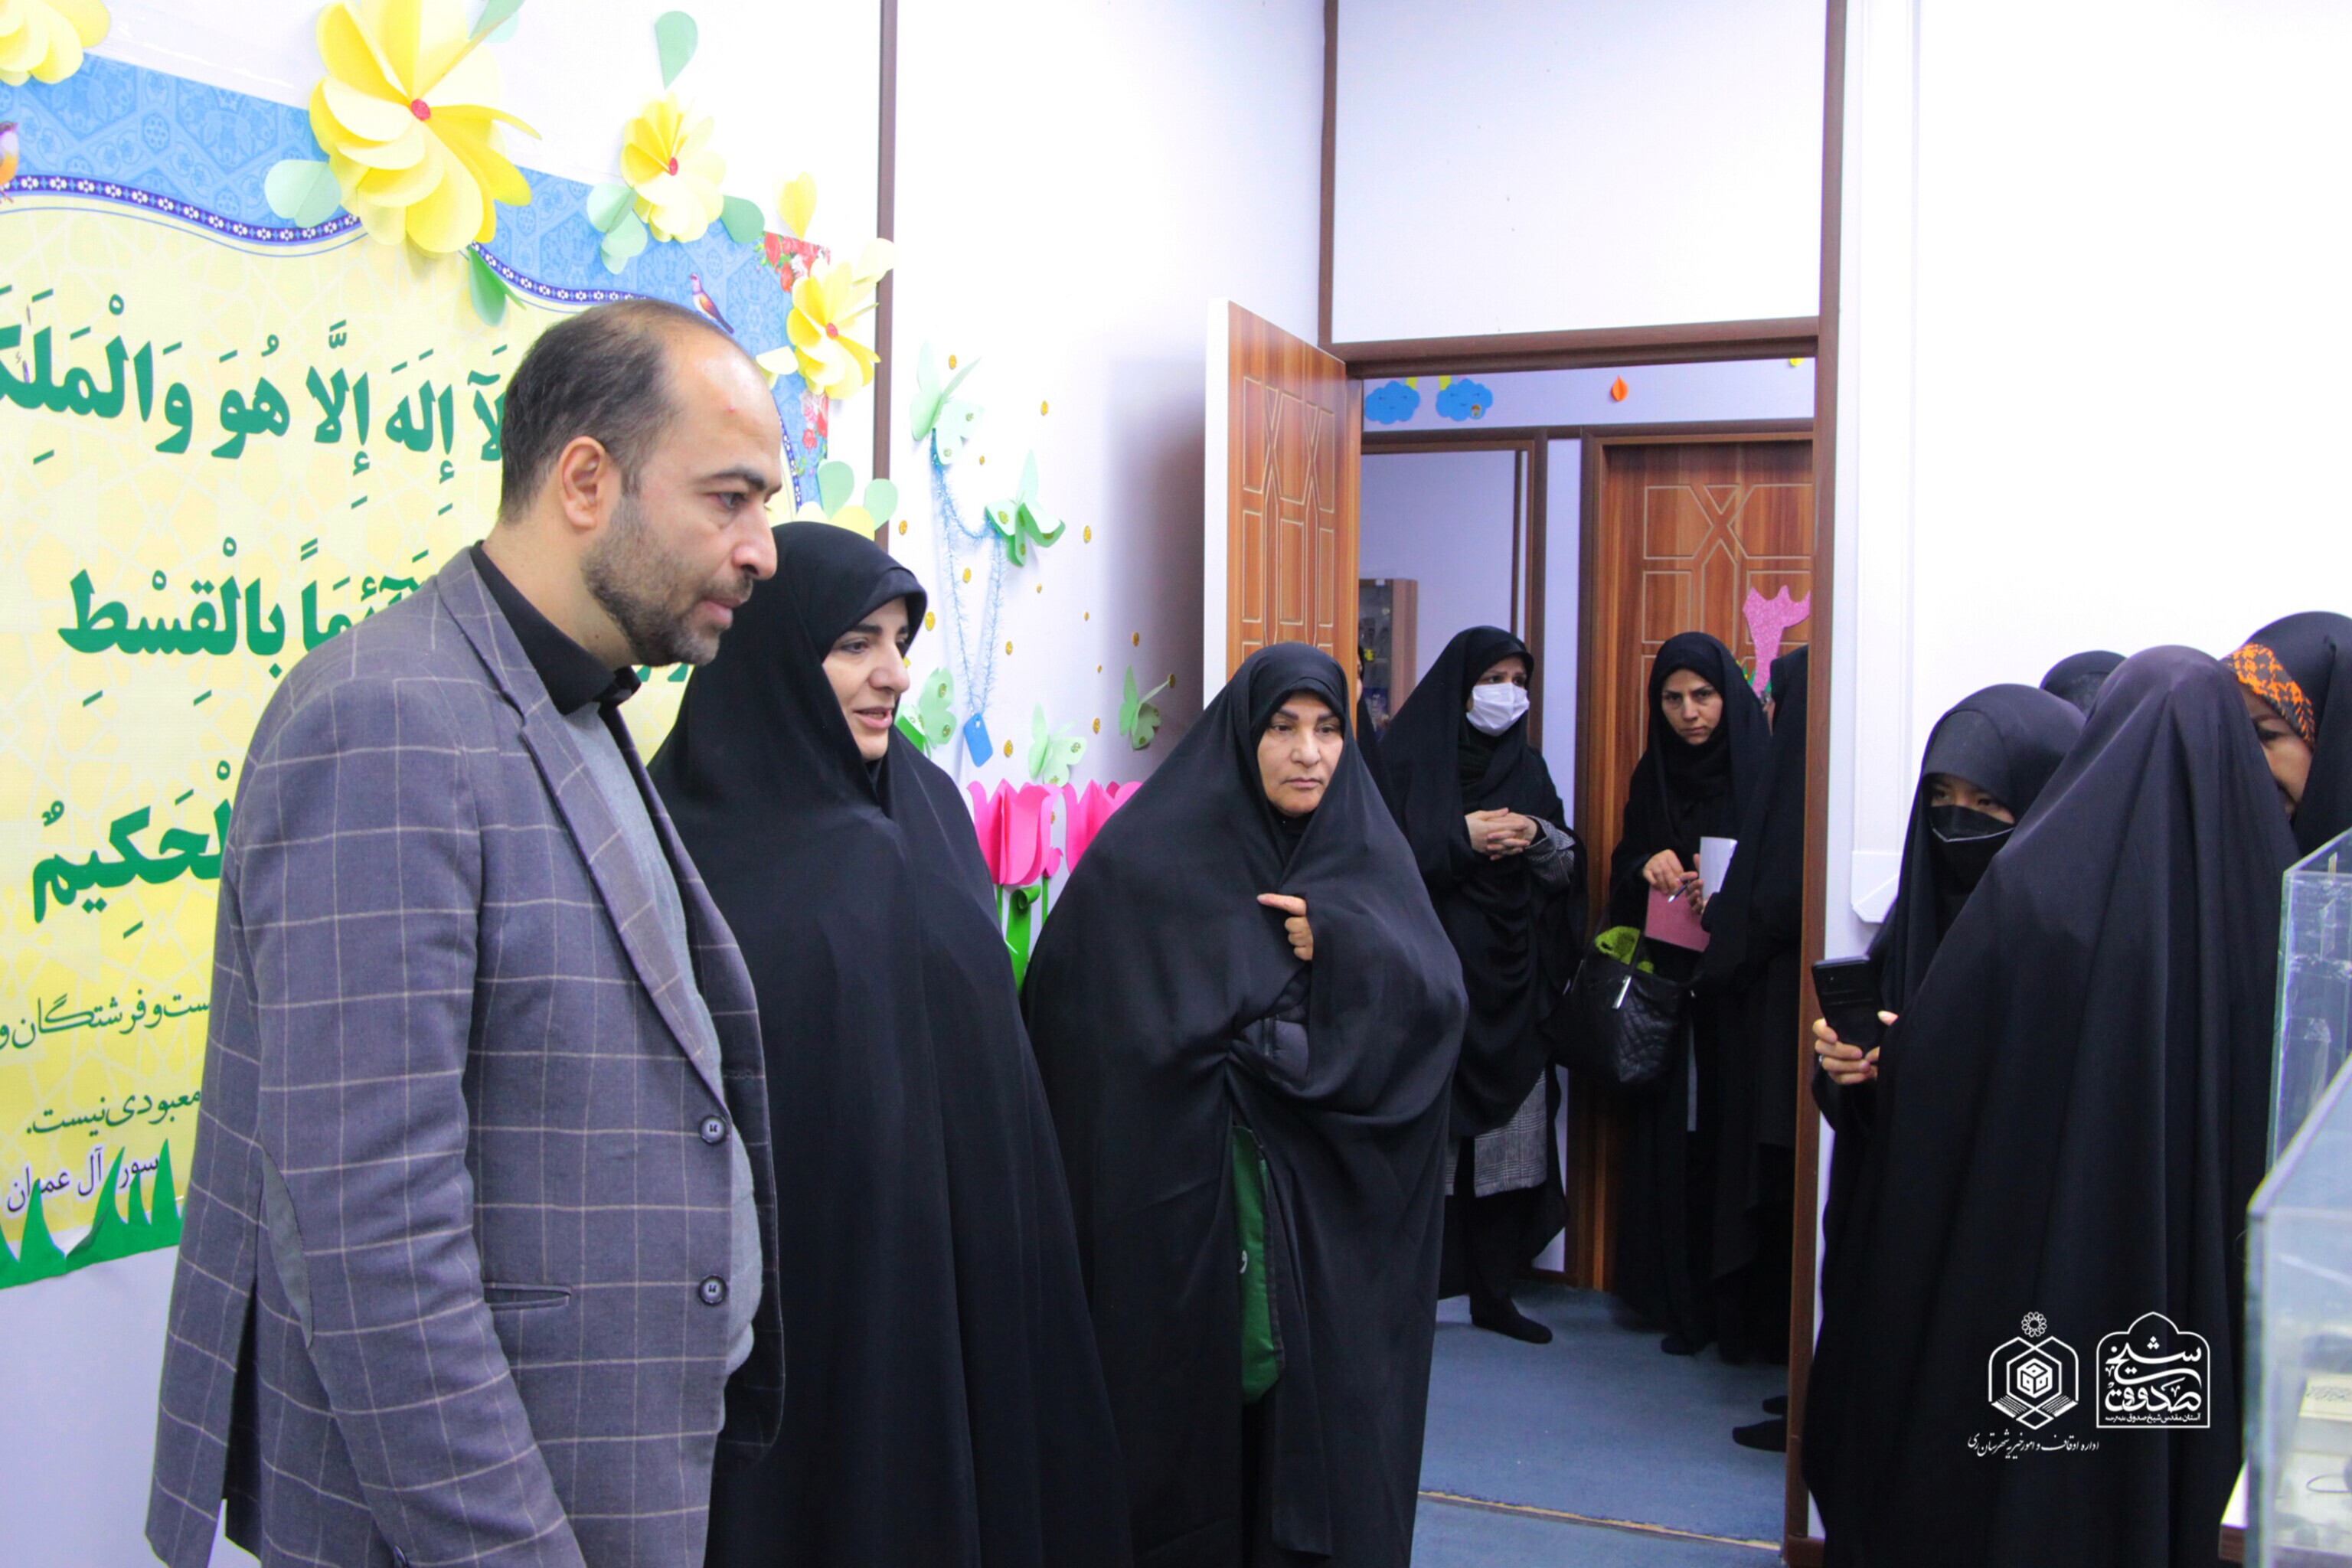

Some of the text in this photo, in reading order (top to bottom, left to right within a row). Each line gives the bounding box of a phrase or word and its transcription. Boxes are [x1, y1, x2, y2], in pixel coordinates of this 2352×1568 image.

[11, 988, 146, 1049] فرشتگان
[7, 1147, 158, 1213] سور آل عمان
